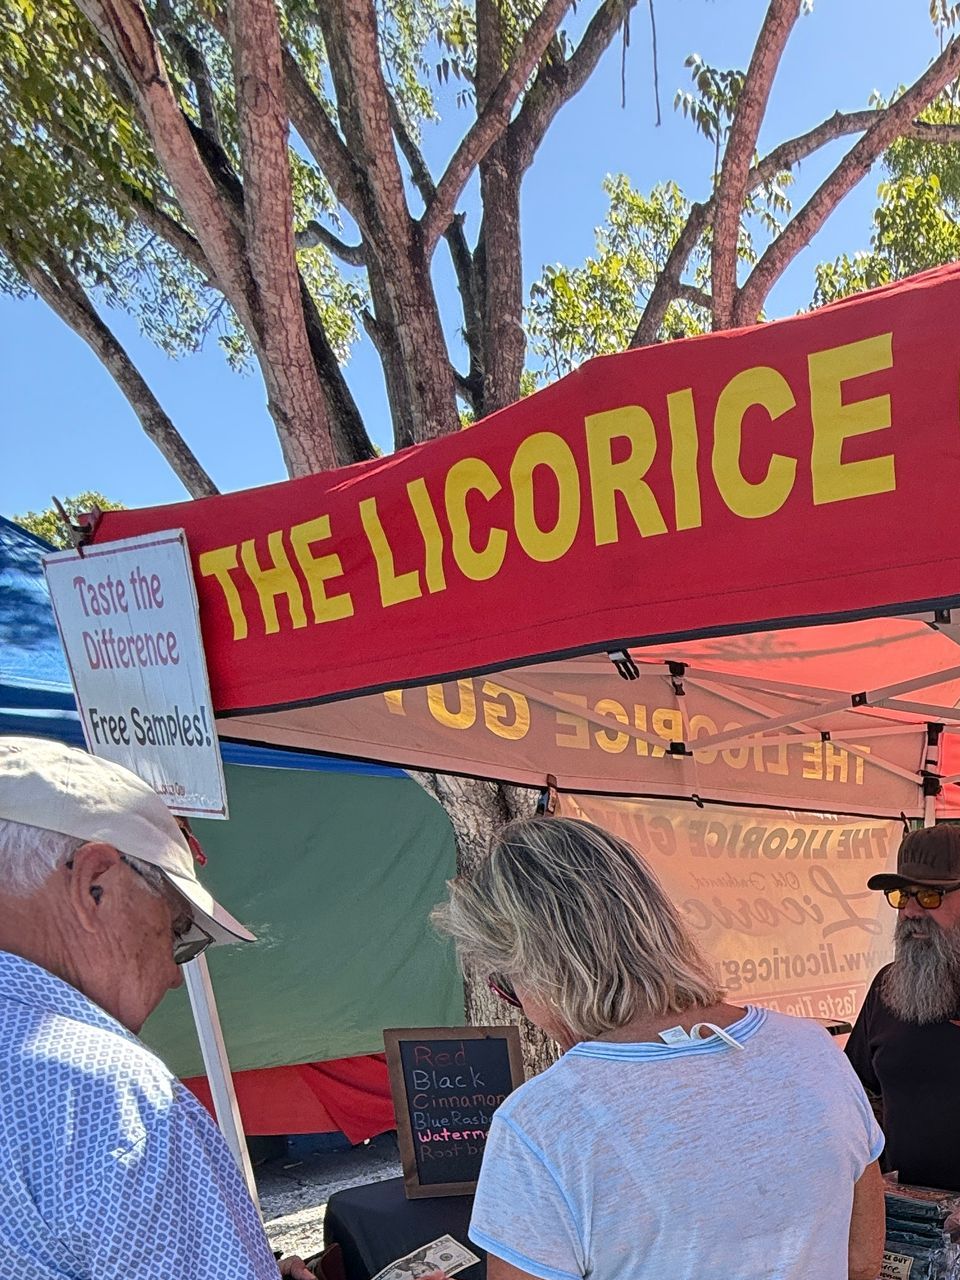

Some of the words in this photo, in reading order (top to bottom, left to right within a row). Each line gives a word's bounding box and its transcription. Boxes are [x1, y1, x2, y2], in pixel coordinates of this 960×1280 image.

[200, 515, 354, 640] THE
[359, 332, 896, 606] LICORICE
[73, 574, 129, 617] Taste
[130, 566, 164, 610] the
[82, 628, 180, 670] Difference
[89, 707, 131, 745] Free
[130, 705, 212, 748] Samples!
[414, 1041, 466, 1067] Red
[412, 1066, 486, 1091] Black
